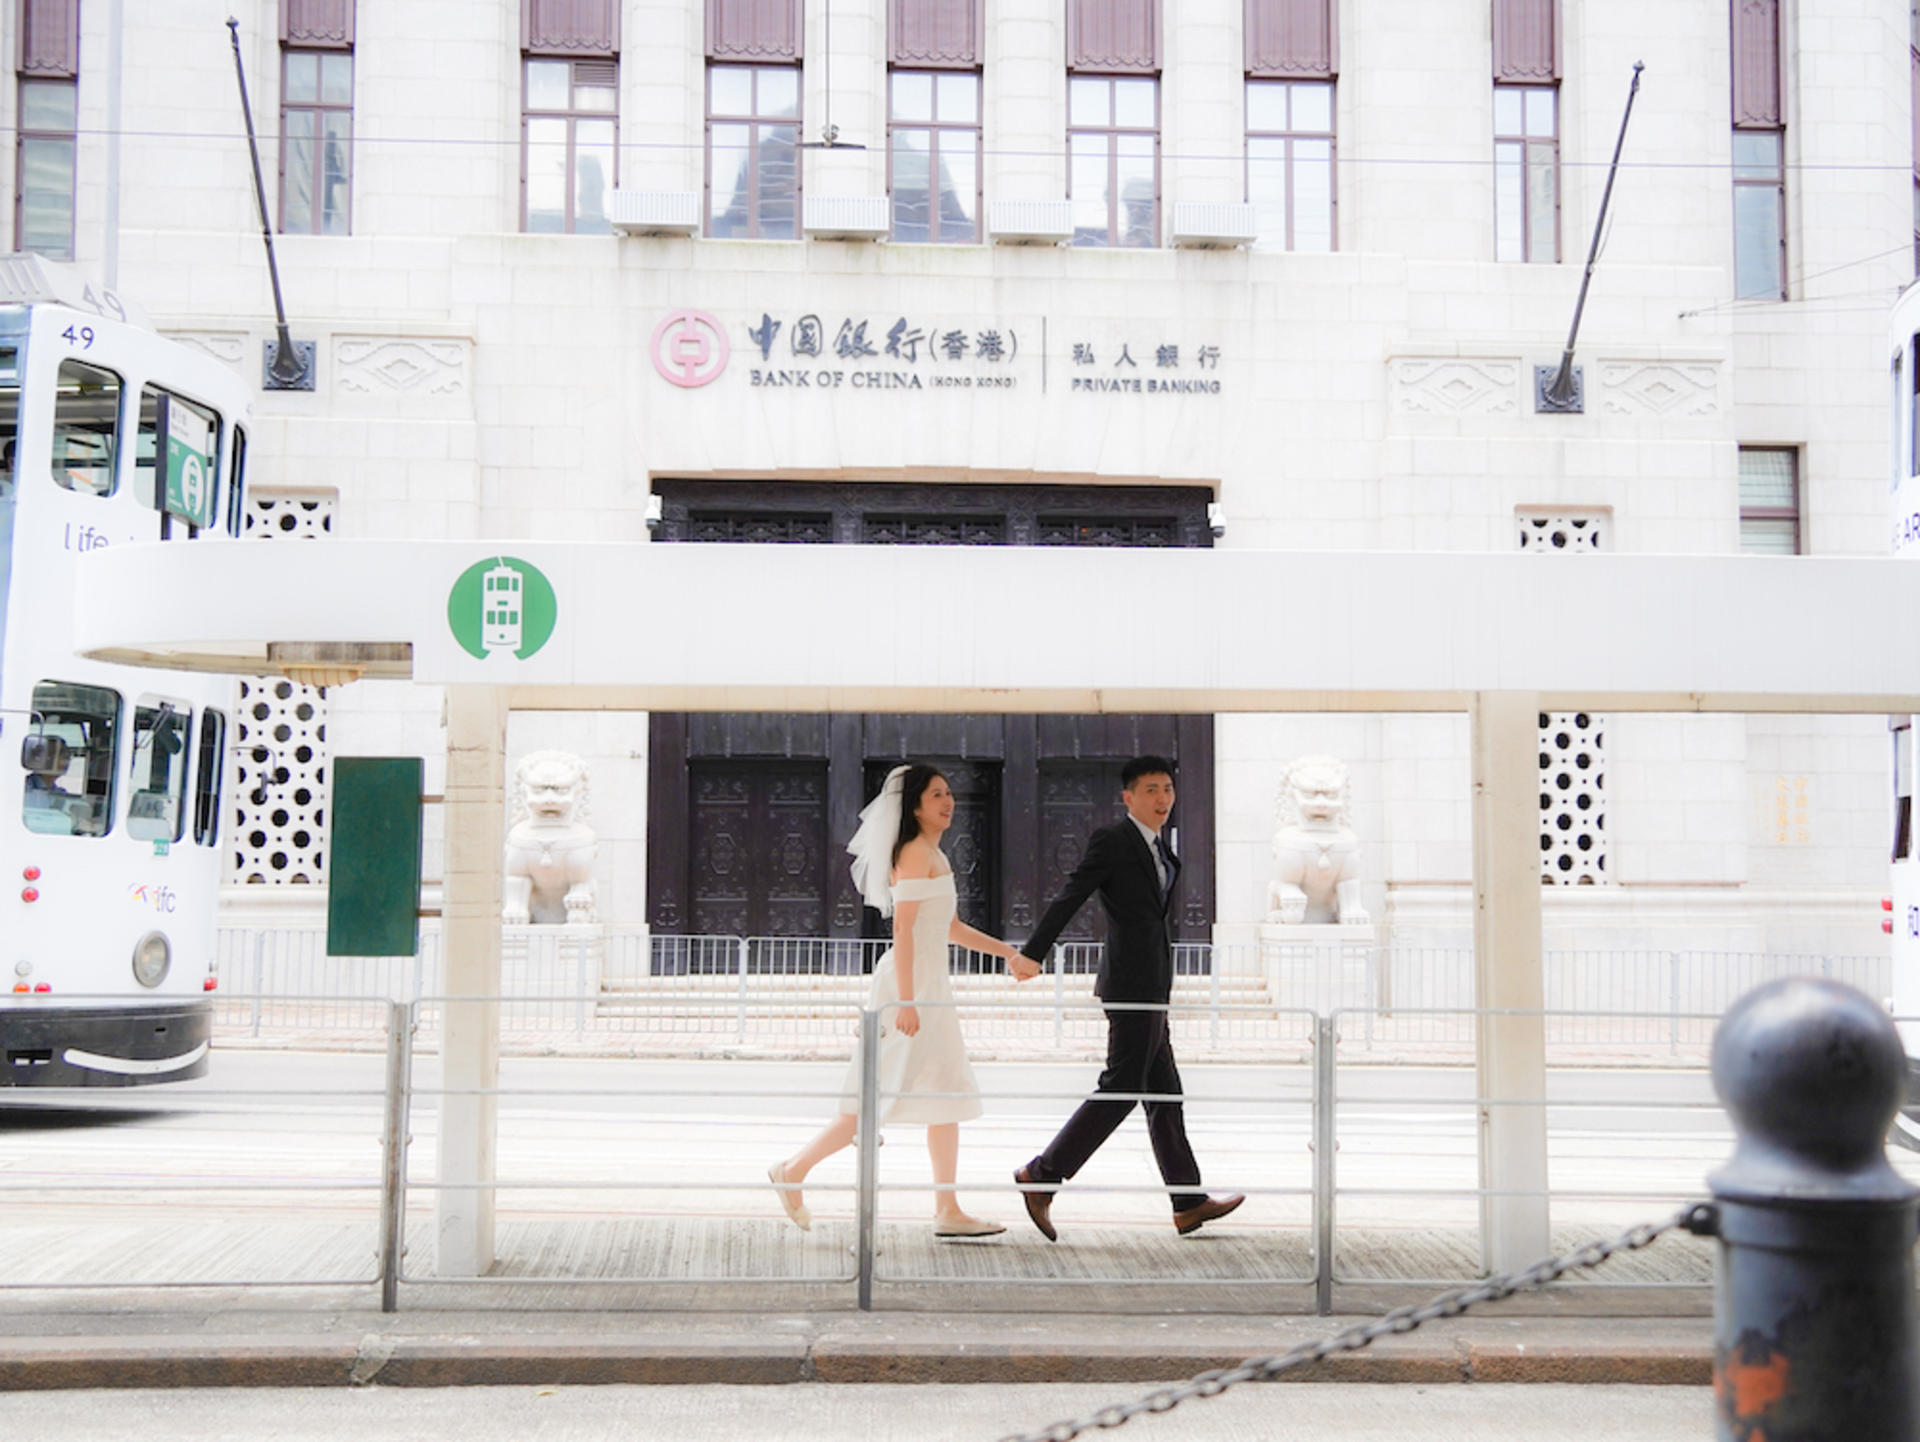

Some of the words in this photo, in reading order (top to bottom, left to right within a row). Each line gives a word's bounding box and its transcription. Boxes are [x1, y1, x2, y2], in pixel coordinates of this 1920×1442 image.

[61, 325, 95, 350] 49
[1072, 343, 1221, 370] 私人銀行
[749, 369, 810, 387] BANK
[816, 370, 844, 387] OF
[851, 371, 922, 390] CHINA
[1072, 377, 1142, 393] PRIVATE
[1147, 379, 1221, 395] BANKING
[156, 885, 177, 913] ifc
